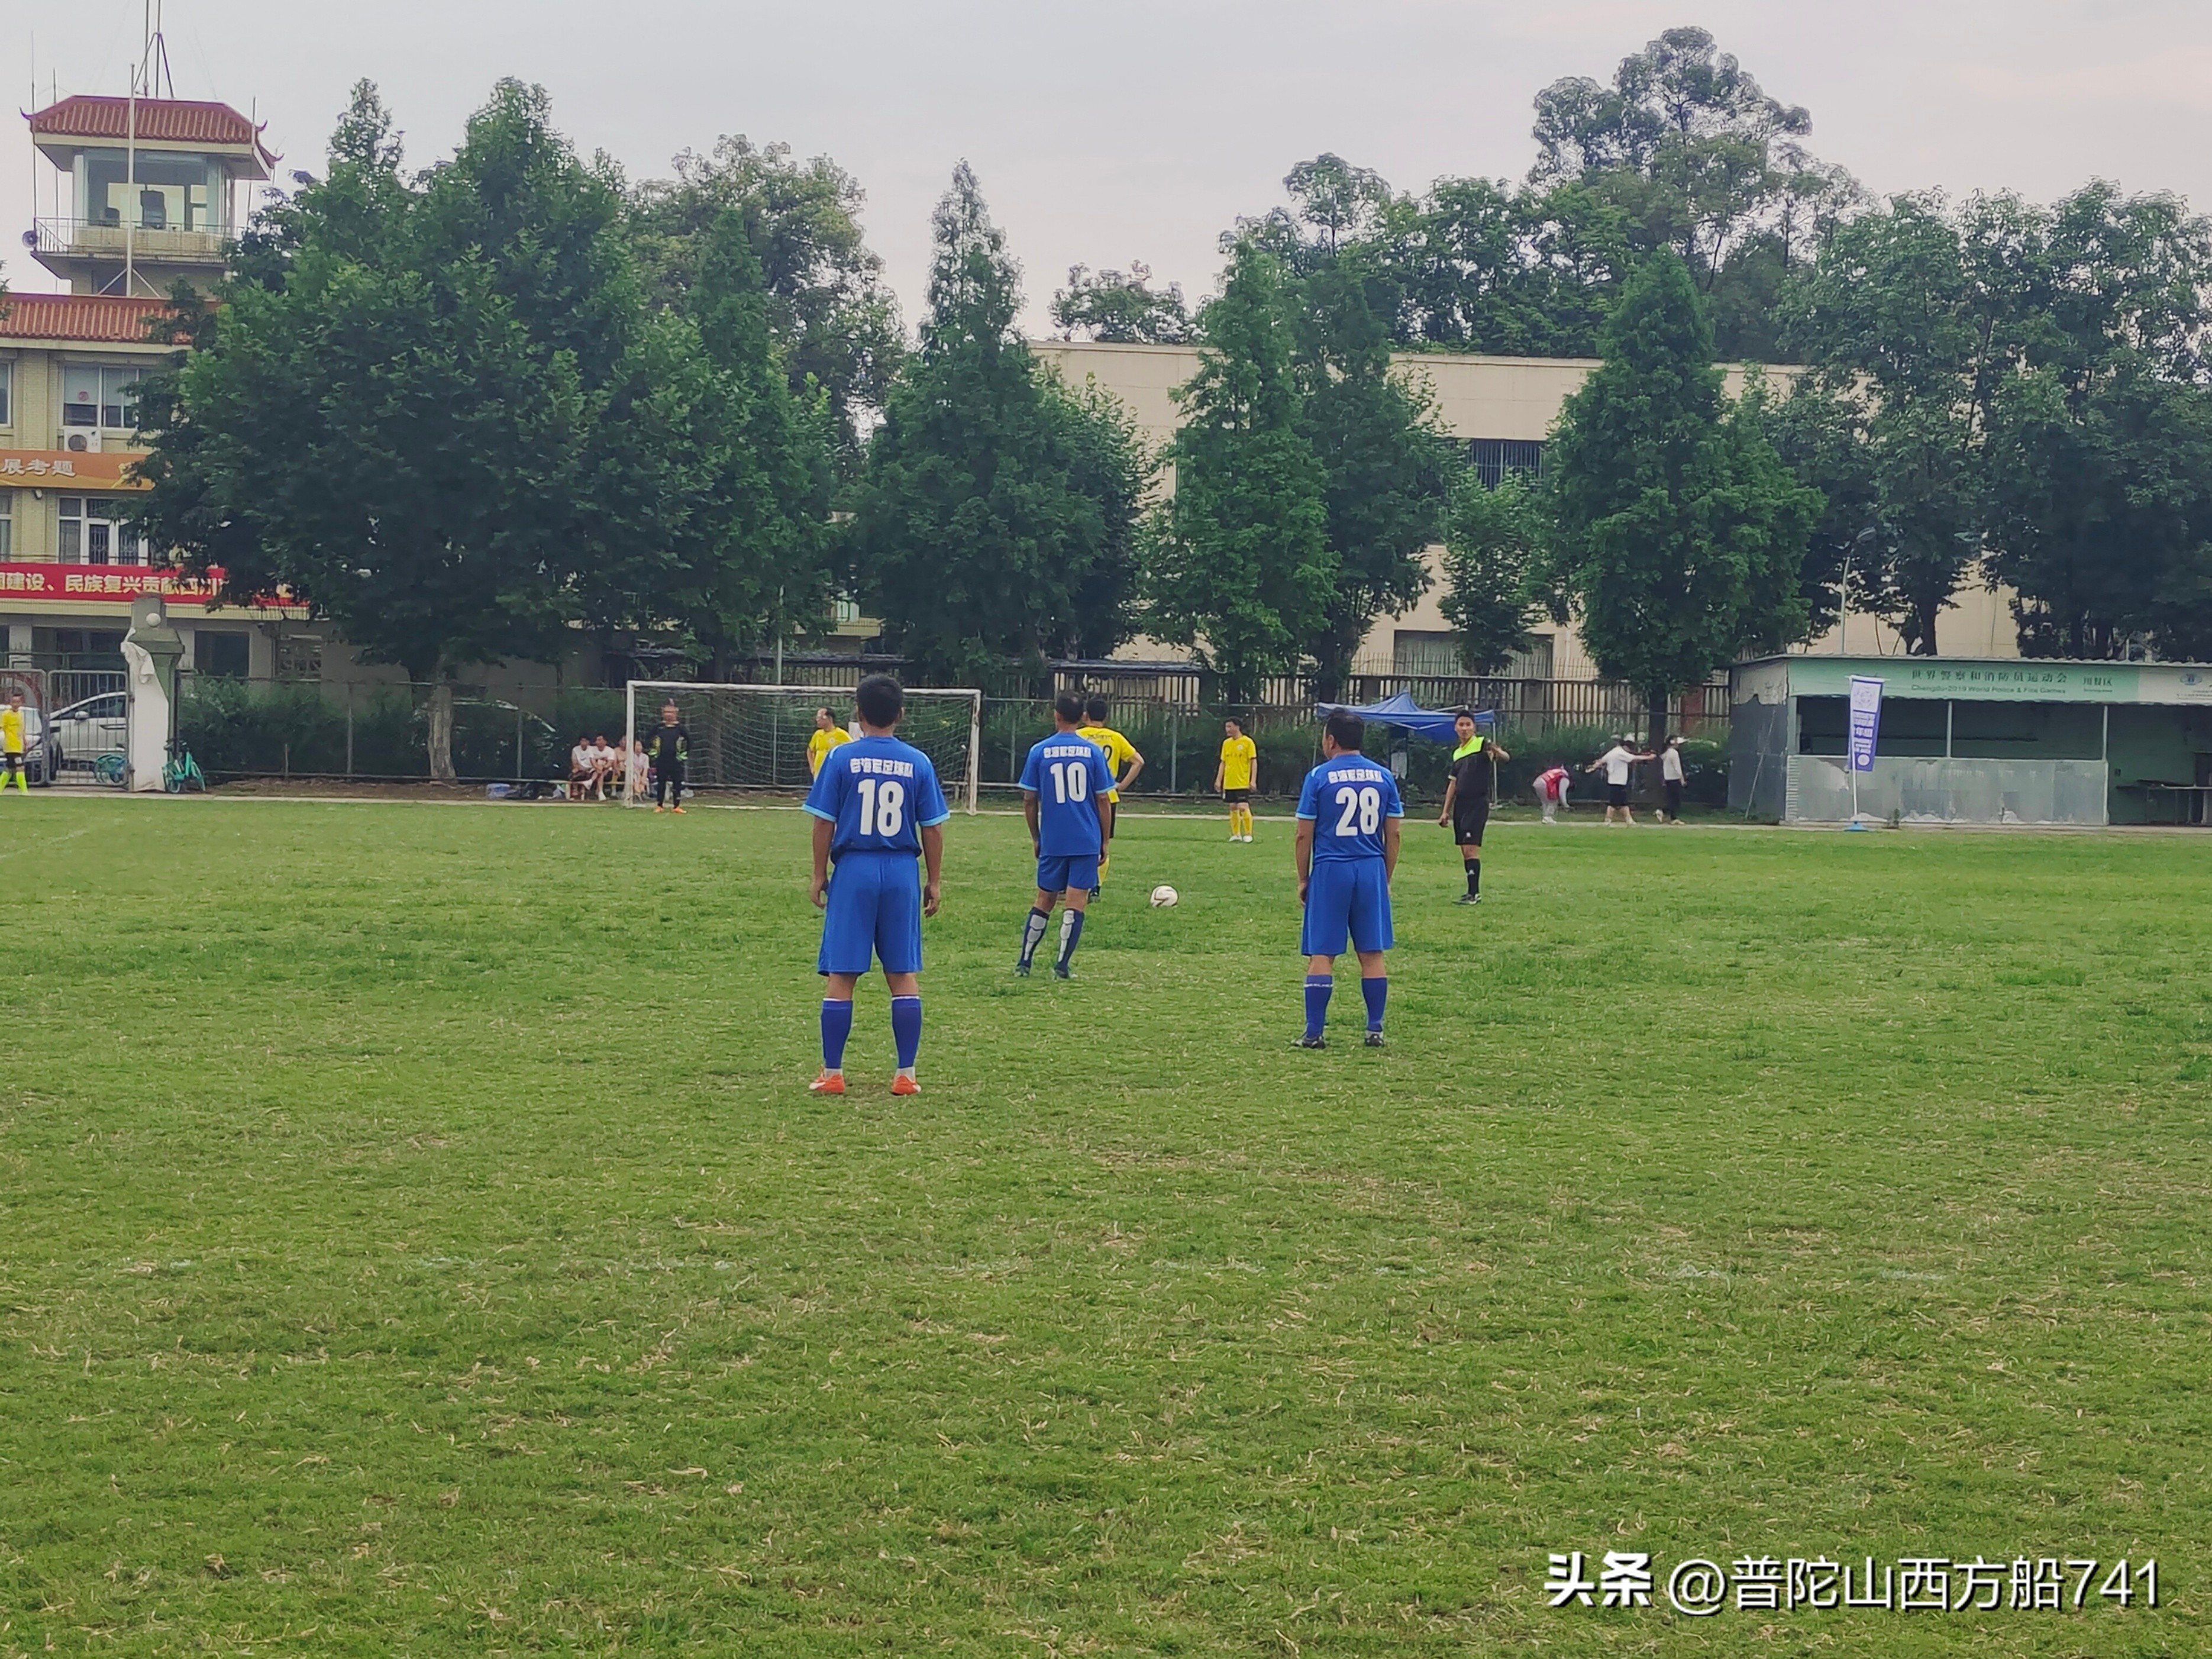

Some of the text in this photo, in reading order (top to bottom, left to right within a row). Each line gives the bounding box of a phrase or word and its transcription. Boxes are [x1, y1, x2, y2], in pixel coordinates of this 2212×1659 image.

[857, 778, 904, 837] 18
[1050, 761, 1087, 804] 10
[1335, 786, 1380, 837] 28
